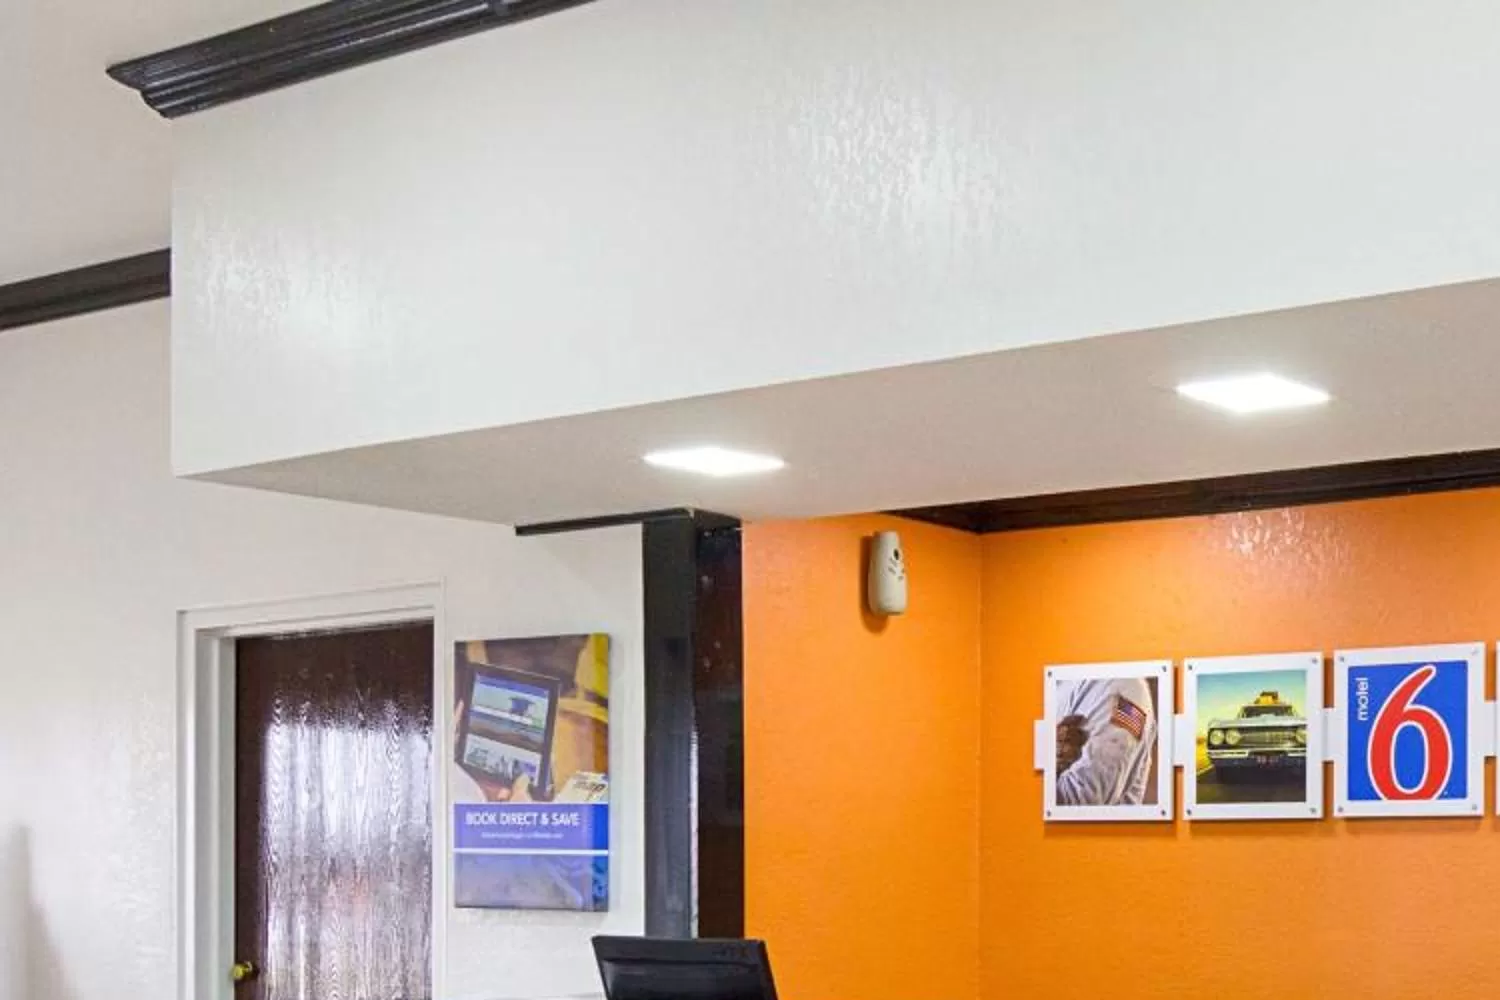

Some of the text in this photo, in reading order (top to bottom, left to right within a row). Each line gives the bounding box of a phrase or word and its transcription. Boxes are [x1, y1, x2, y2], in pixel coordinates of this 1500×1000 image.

[1355, 677, 1369, 721] motel
[1367, 664, 1453, 801] 6
[465, 812, 498, 825] BOOK
[500, 812, 539, 826] DIRECT
[551, 812, 581, 827] SAVE
